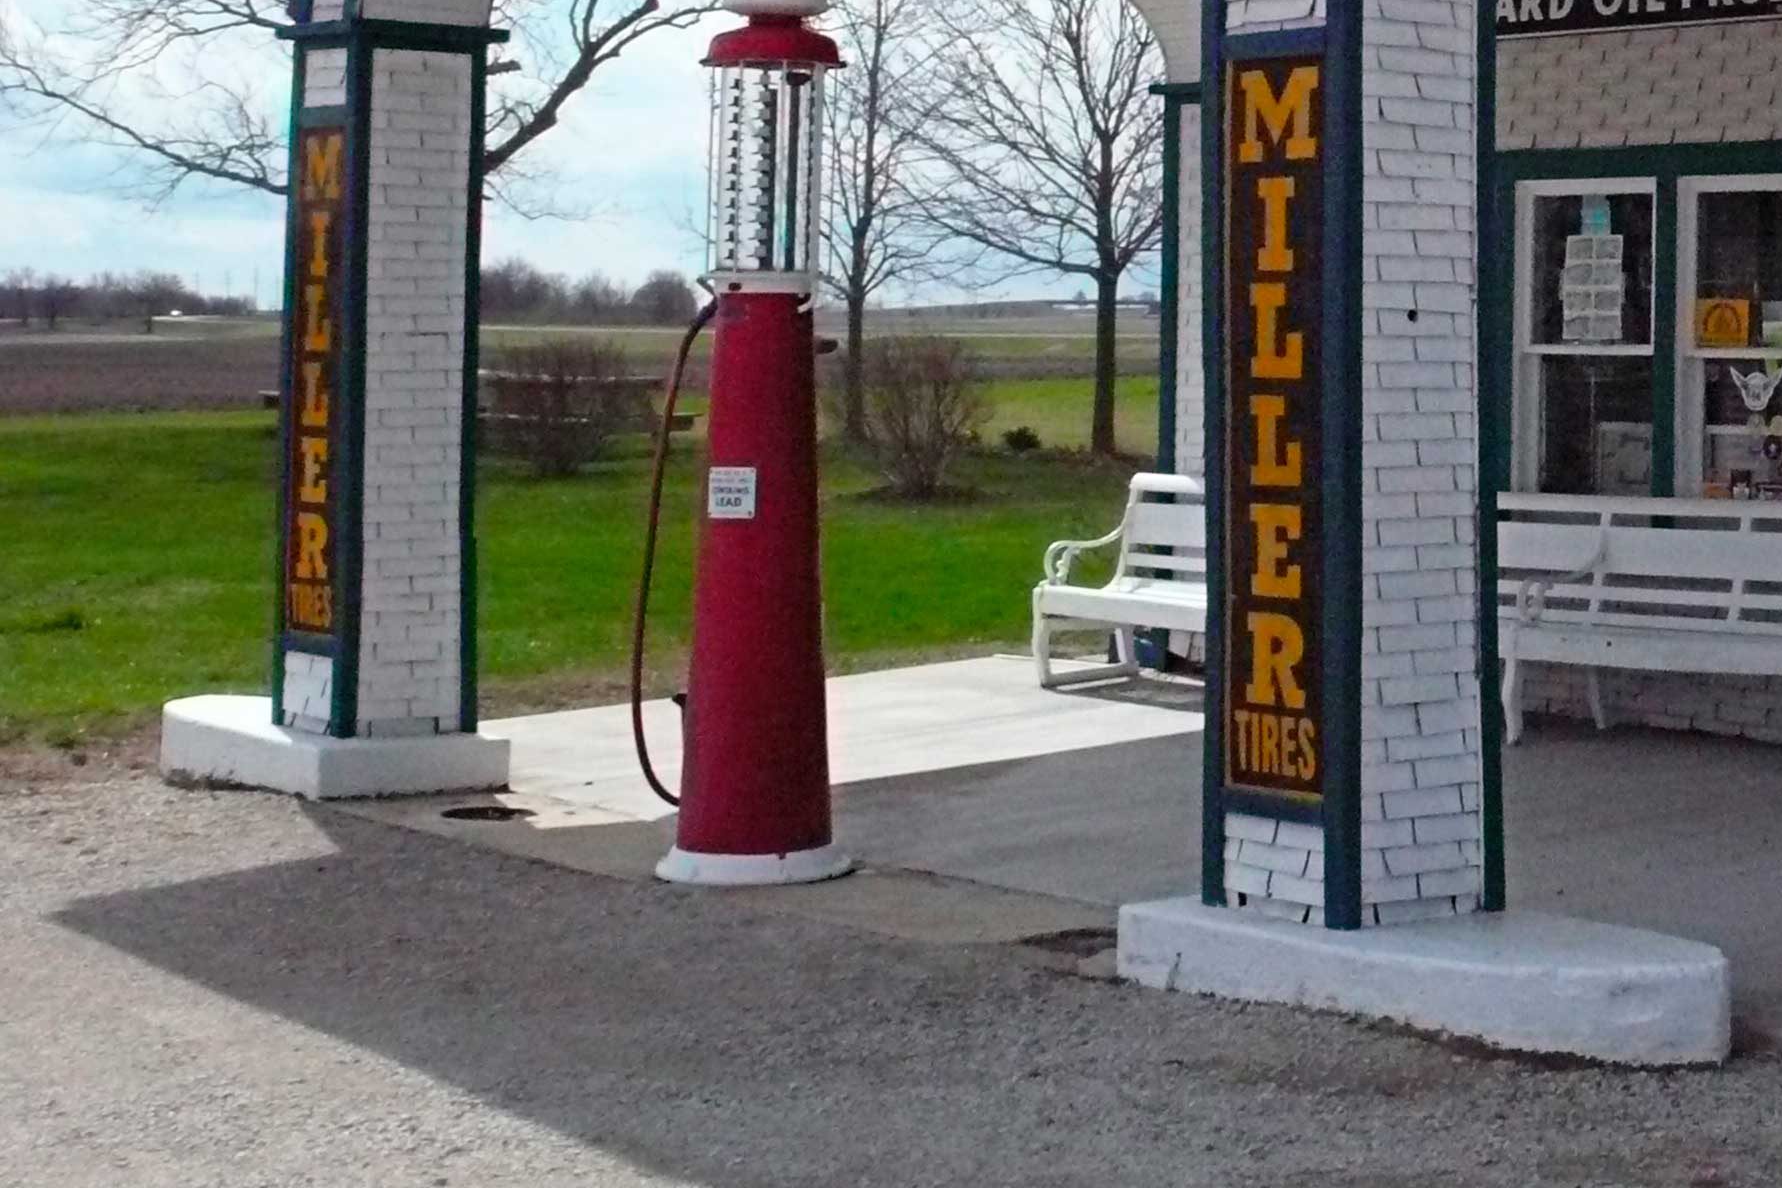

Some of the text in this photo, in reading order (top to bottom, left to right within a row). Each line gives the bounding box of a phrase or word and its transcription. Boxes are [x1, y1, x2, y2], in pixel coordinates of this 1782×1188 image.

[295, 134, 342, 579] MILLER
[1239, 65, 1320, 710] MILLER
[715, 497, 742, 507] LEAD
[1233, 709, 1316, 781] TIRES
